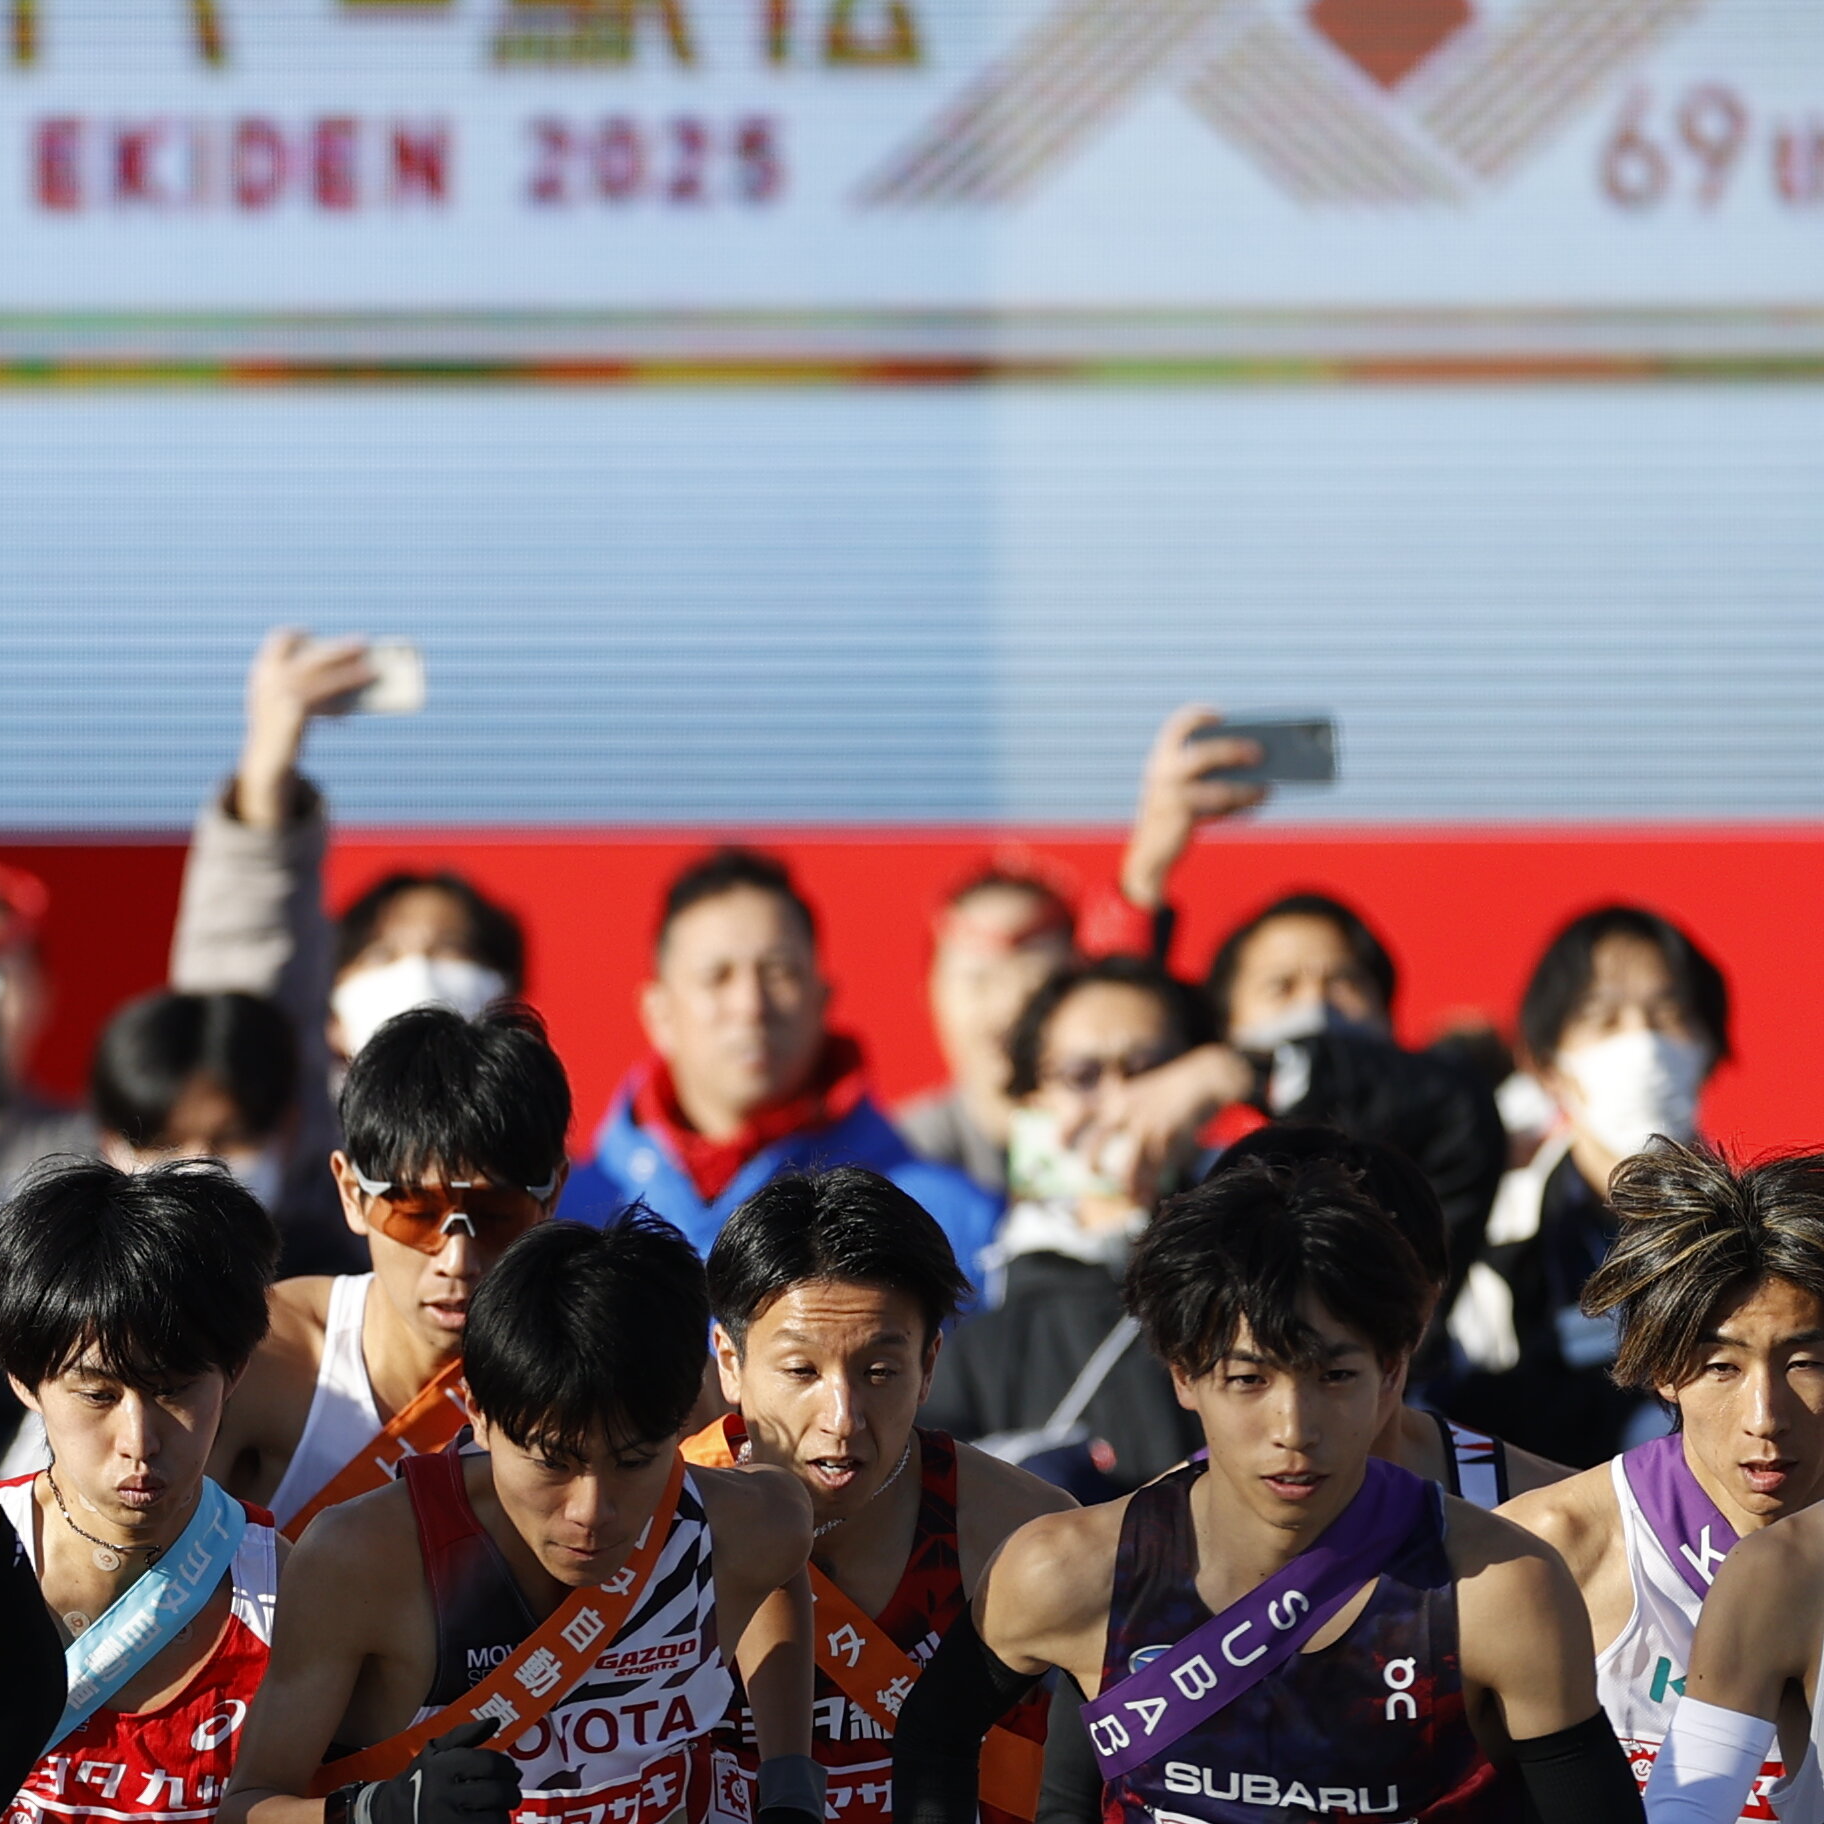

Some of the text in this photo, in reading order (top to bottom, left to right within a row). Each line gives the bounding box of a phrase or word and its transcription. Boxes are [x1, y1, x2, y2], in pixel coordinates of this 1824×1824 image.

[32, 115, 450, 208] EKIDEN
[526, 115, 784, 206] 2025
[470, 1516, 654, 1738] タ自動車
[593, 1638, 697, 1670] GAZOO
[614, 1659, 681, 1677] SPORTS
[1164, 1761, 1399, 1816] SUBARU
